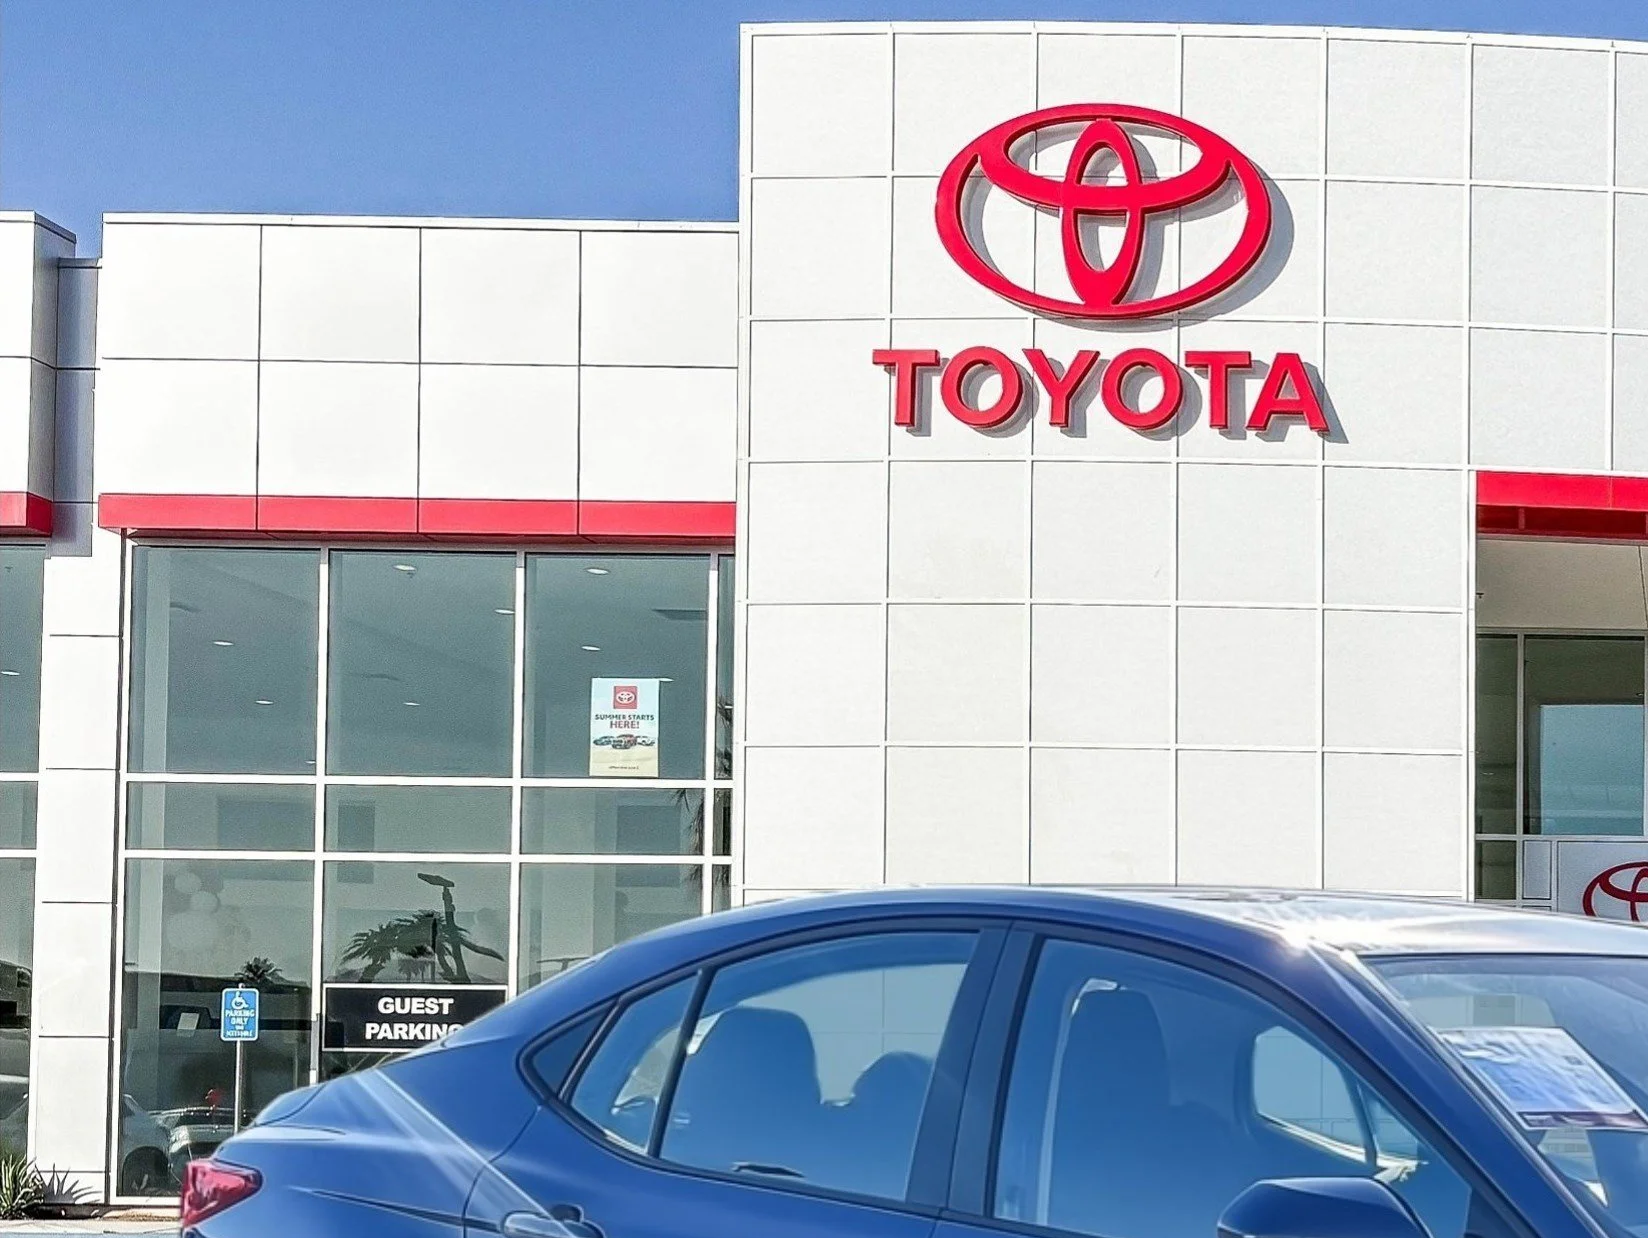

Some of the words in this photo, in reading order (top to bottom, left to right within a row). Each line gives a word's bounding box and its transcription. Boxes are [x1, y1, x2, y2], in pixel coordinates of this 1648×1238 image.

[872, 345, 1330, 433] TOYOTA
[609, 721, 640, 729] HERE!
[377, 997, 454, 1014] GUEST
